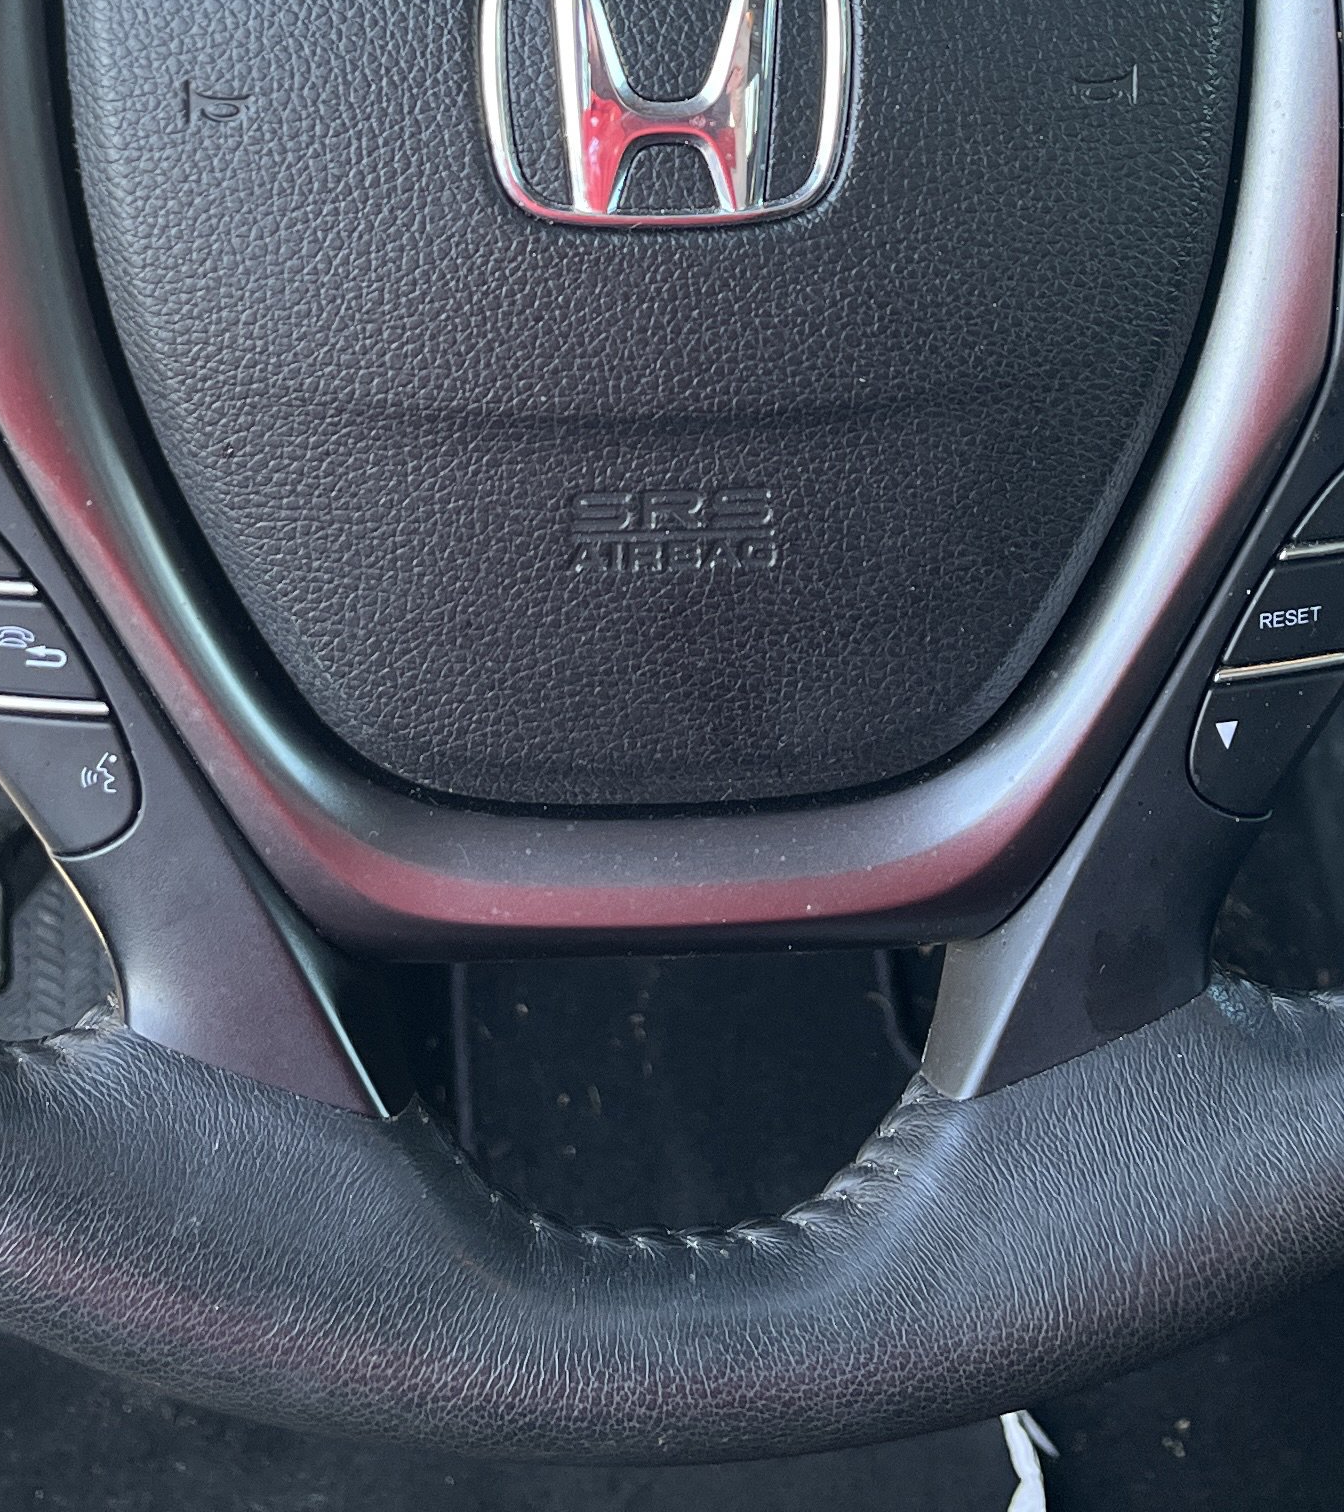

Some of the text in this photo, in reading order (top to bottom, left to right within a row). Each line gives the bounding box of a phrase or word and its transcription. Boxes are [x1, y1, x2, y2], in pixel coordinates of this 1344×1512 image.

[572, 491, 775, 532] SRS
[570, 541, 778, 573] AIRBAG
[1259, 605, 1322, 630] RESET
